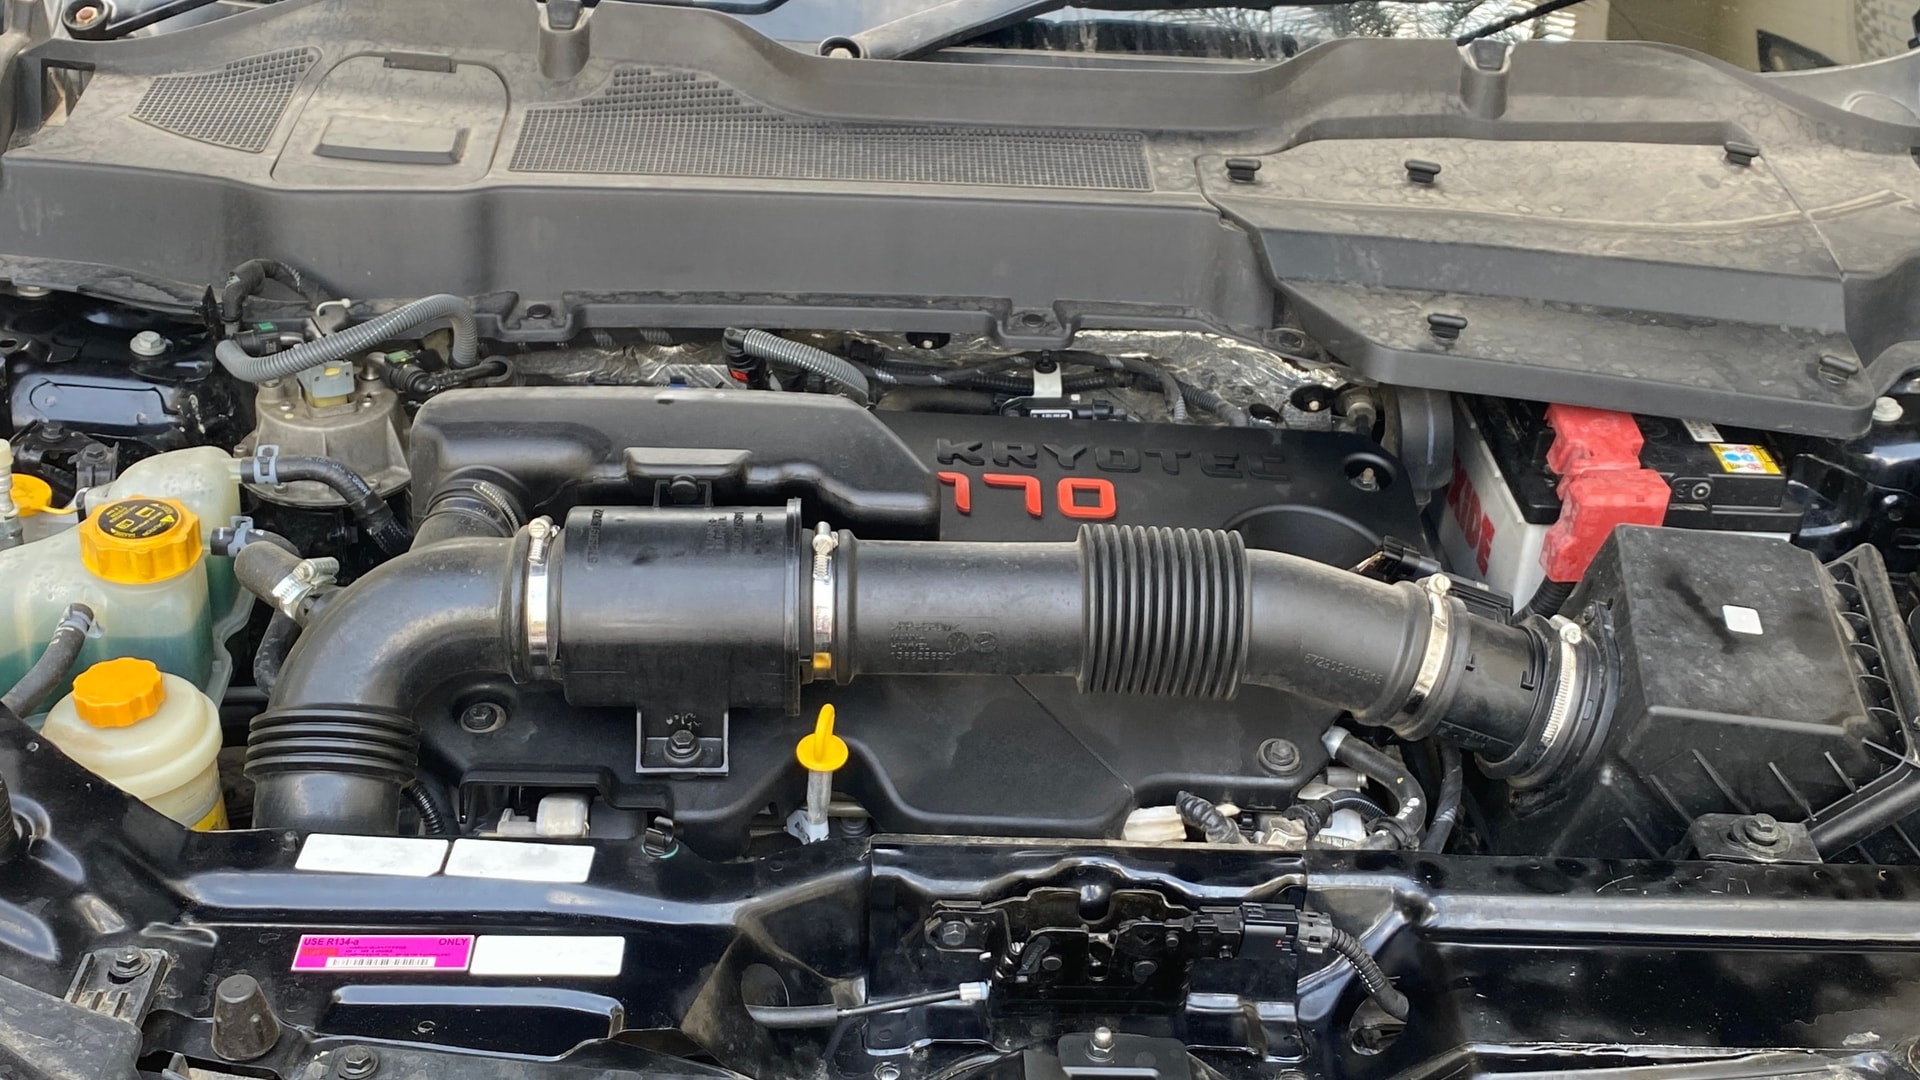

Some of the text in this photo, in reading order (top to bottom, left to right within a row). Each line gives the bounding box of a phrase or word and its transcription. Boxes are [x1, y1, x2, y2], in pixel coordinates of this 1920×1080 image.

[936, 438, 1290, 480] KRYOTEC
[937, 471, 1118, 519] 170
[1446, 456, 1496, 578] XIDE
[303, 938, 469, 946] USE R134-a ONLY
